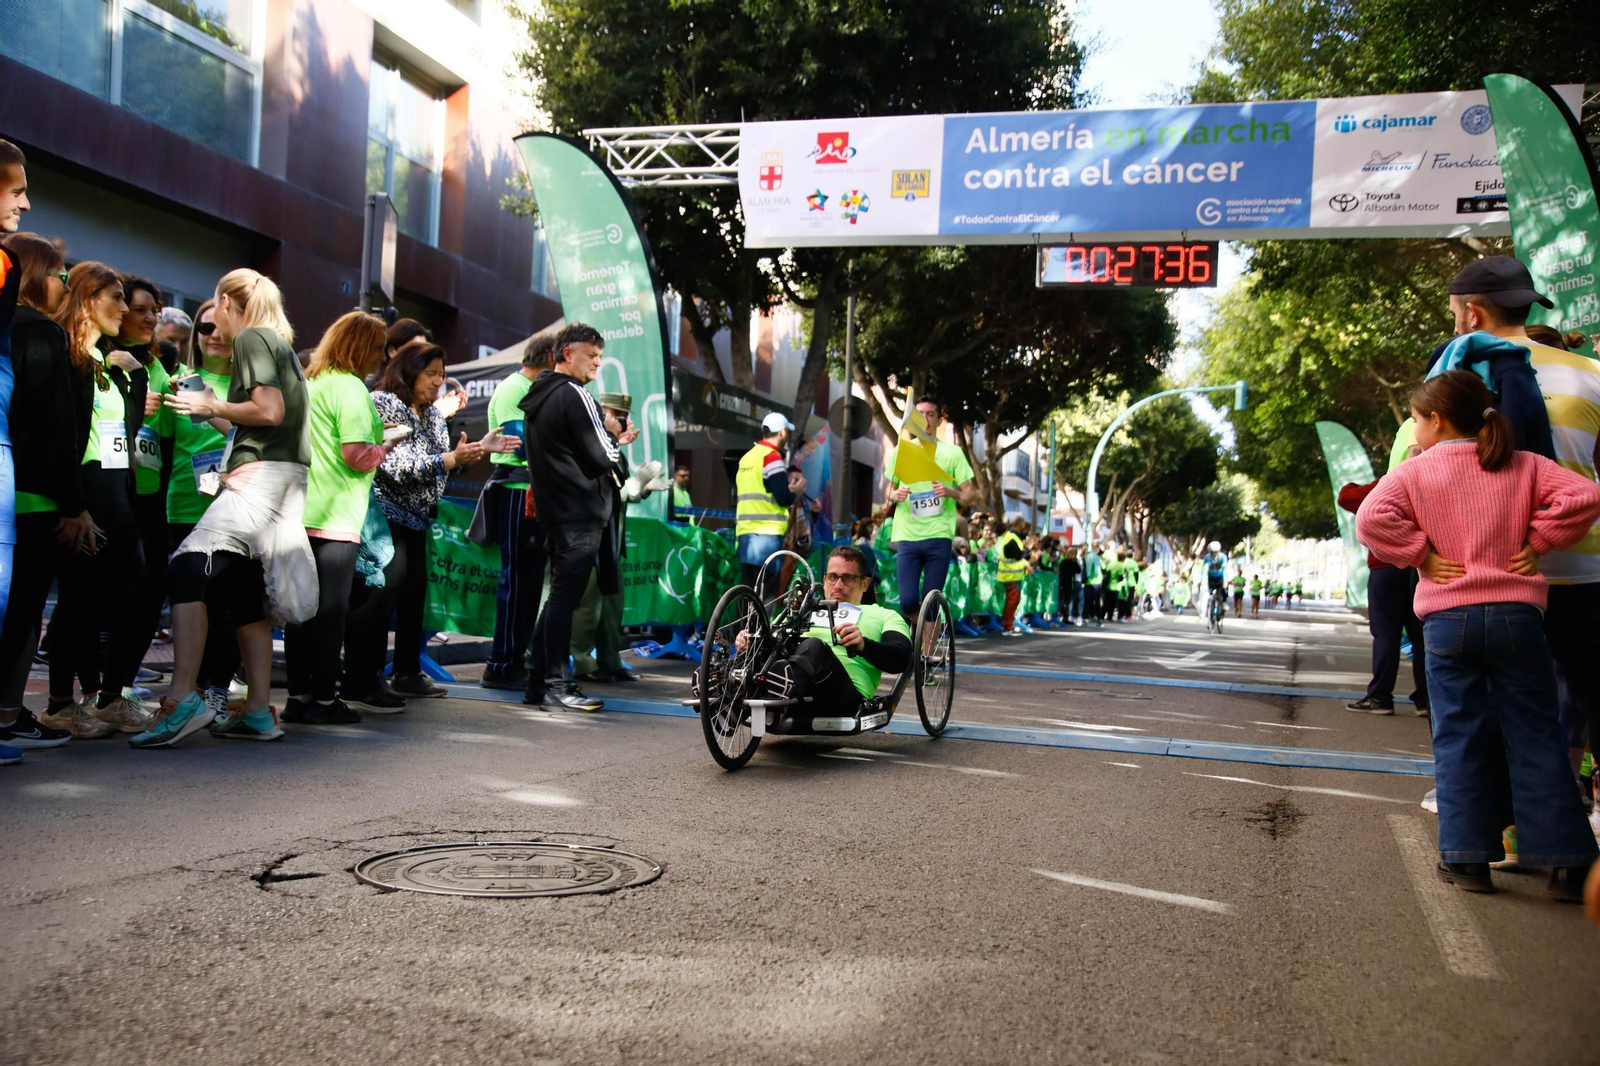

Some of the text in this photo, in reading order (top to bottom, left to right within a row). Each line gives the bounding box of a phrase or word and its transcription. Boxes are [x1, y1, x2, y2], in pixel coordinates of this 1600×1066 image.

[1362, 113, 1437, 133] cajamar
[965, 116, 1291, 154] Almería en marcha
[896, 172, 926, 184] SOLAN
[964, 157, 1244, 190] contra el cáncer
[1475, 179, 1506, 193] Ejido
[1364, 192, 1401, 201] Toyota
[1364, 201, 1440, 213] Alborán Motor
[953, 211, 1060, 225] #TodosContraElCáncer
[1065, 245, 1211, 283] 00:27:36
[913, 497, 940, 509] 1530
